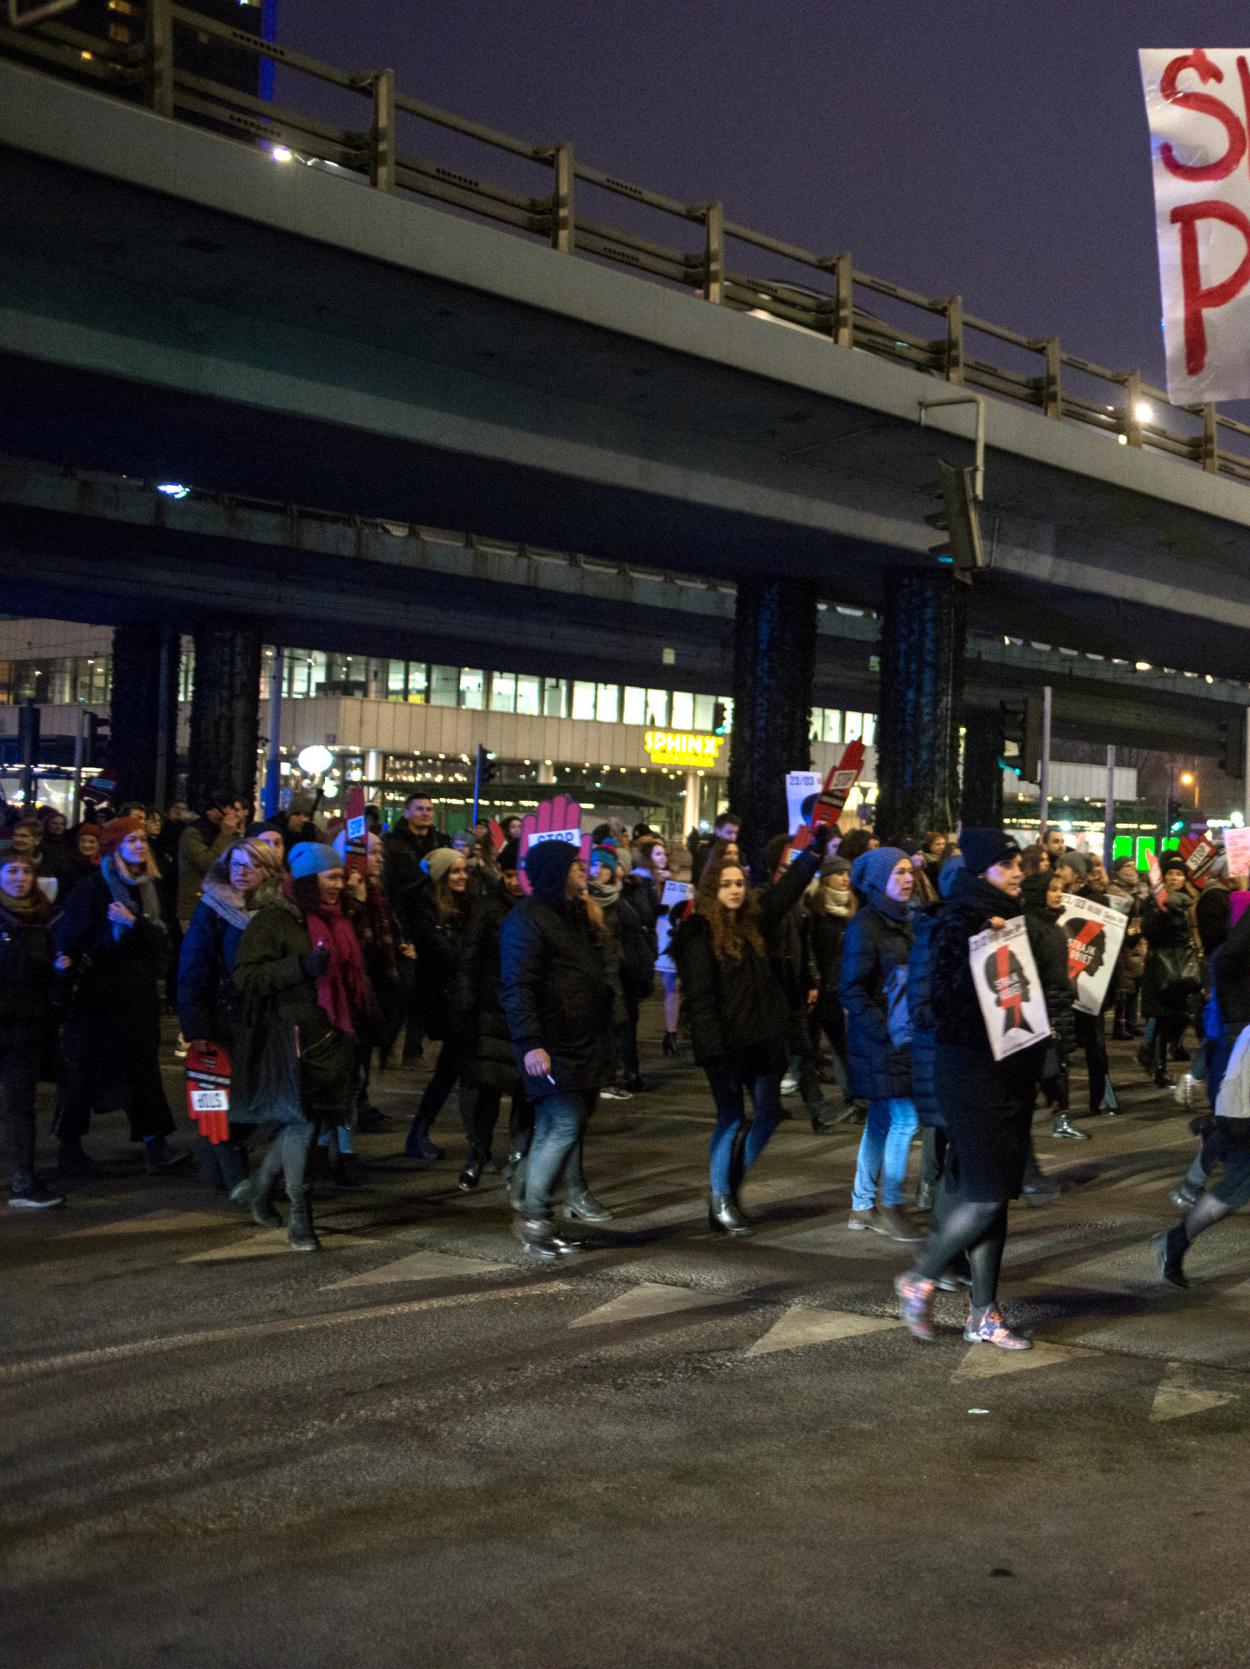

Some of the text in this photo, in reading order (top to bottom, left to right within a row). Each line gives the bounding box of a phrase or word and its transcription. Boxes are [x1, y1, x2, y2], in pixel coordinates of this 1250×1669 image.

[644, 731, 718, 757] SPHINX
[1190, 844, 1207, 866] STOP
[197, 1092, 222, 1109] STOP
